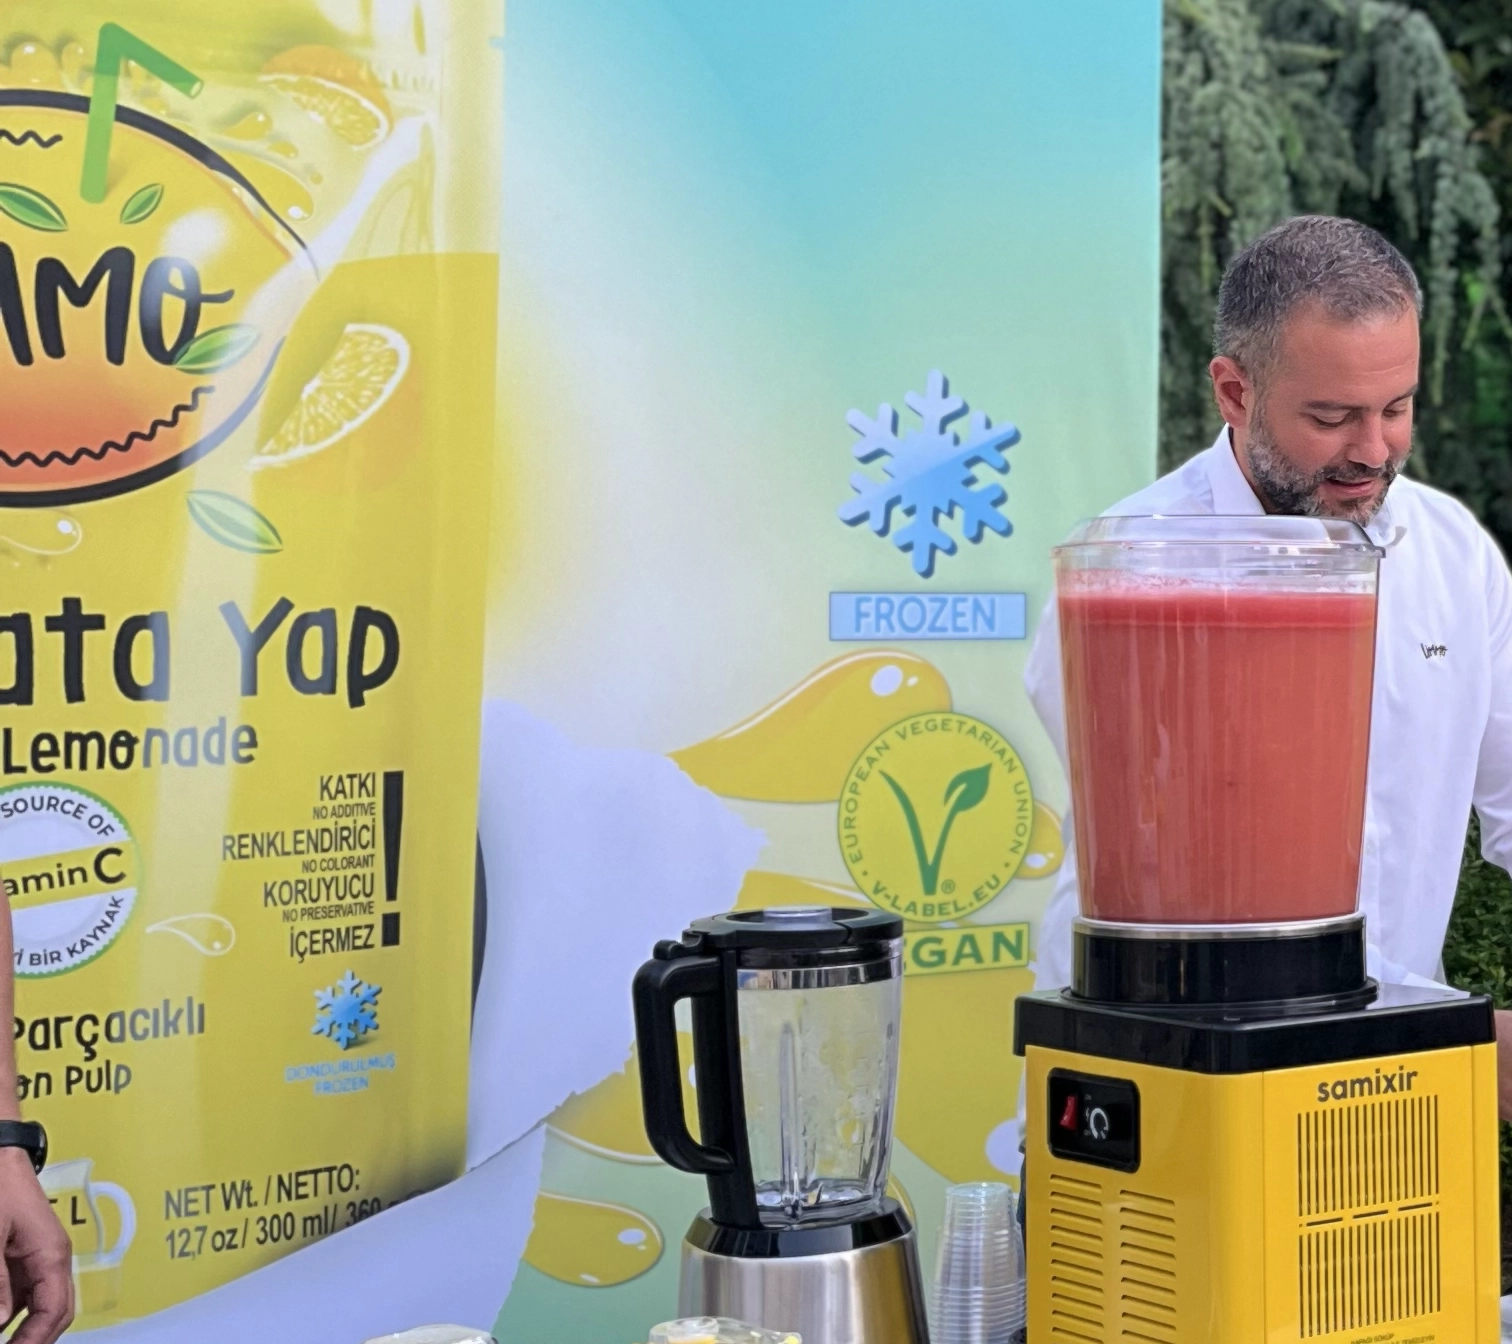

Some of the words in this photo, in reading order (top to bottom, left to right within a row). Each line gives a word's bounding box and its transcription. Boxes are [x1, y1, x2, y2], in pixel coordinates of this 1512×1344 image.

[855, 595, 996, 634] FROZEN
[218, 596, 400, 709] Yap
[2, 716, 258, 775] Lemonade
[319, 772, 376, 801] KATKI
[843, 739, 891, 864] EUROPEAN
[895, 718, 1017, 774] VEGETARIAN
[1010, 780, 1029, 855] UNION
[0, 795, 88, 819] SOURCE
[88, 814, 115, 837] OF
[312, 806, 328, 820] NO
[330, 802, 376, 819] ADDITIVE
[222, 818, 376, 861] RENKLENDİRİCİ
[94, 847, 127, 885] C
[302, 859, 317, 873] NO
[319, 854, 375, 873] COLORANT
[264, 873, 375, 907] KORUYUCU
[872, 873, 1001, 917] V-LABEL.EU
[29, 948, 62, 966] BİR
[66, 896, 124, 958] KAYNAK
[282, 908, 298, 923] NO
[300, 901, 375, 921] PRESERVATIVE
[290, 924, 375, 964] İÇERMEZ
[905, 929, 1024, 969] GAN
[66, 1059, 132, 1095] Pulp
[1317, 1064, 1419, 1102] samixir
[164, 1184, 216, 1220] NET
[221, 1179, 258, 1211] Wt.
[277, 1163, 360, 1203] NETTO:
[256, 1211, 295, 1245] 300
